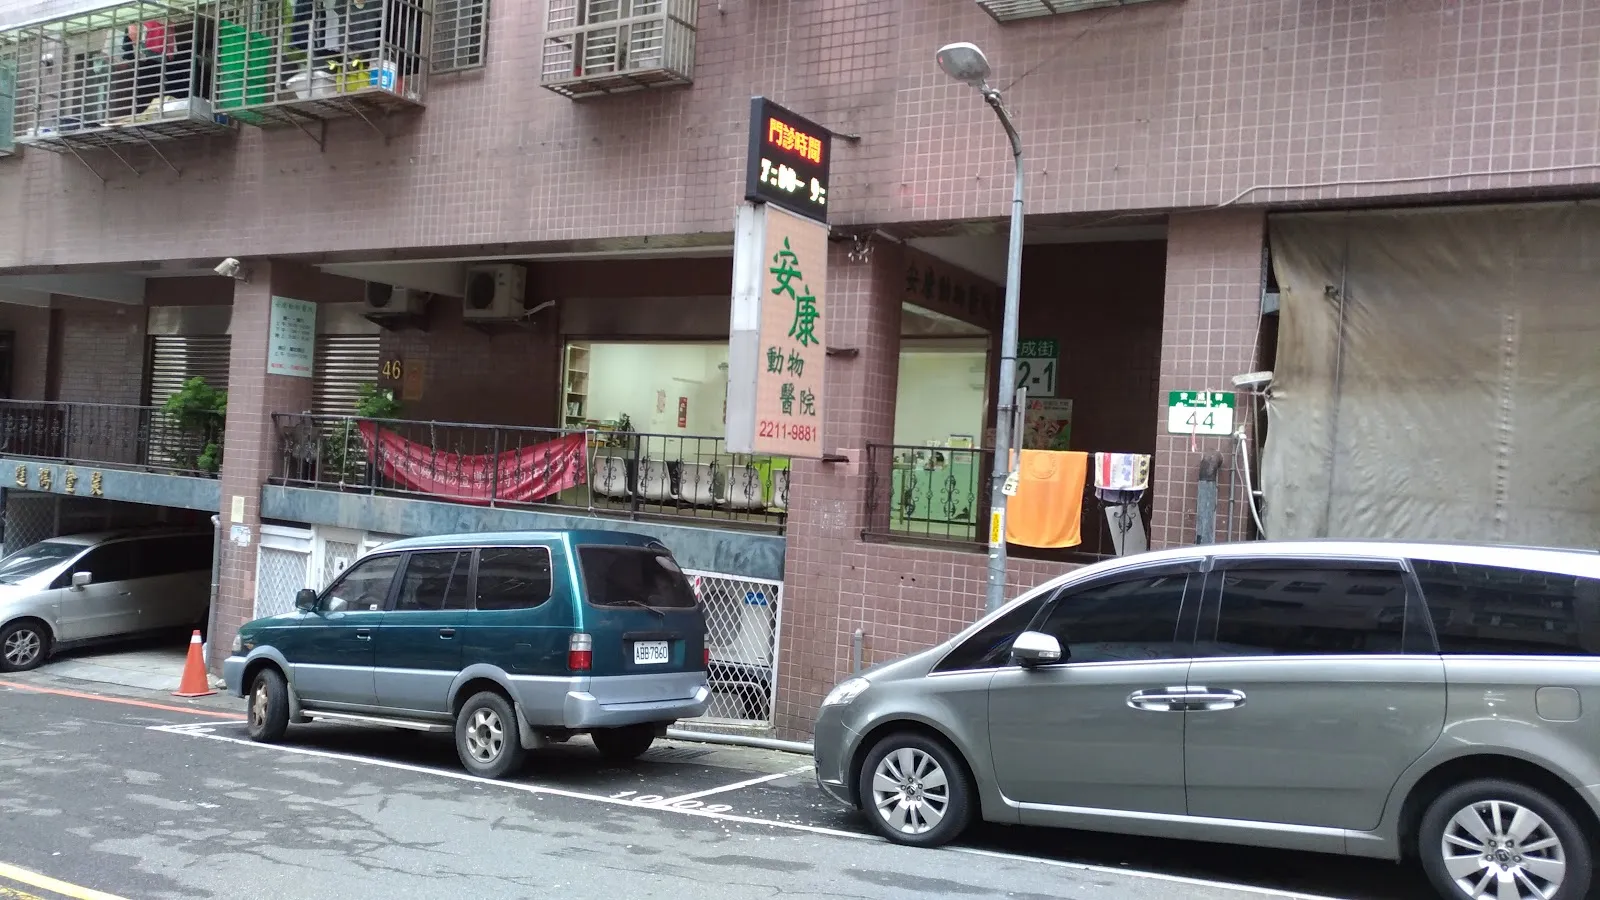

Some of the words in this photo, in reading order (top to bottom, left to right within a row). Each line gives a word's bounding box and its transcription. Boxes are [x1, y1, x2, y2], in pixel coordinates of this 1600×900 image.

[769, 118, 822, 164] 門診時間
[770, 236, 820, 347] 安康
[766, 346, 805, 378] 動物
[1018, 341, 1054, 357] 成街
[382, 360, 401, 380] 46
[779, 382, 816, 416] 醫院
[759, 420, 817, 442] 2211-9881
[1185, 410, 1216, 430] 44
